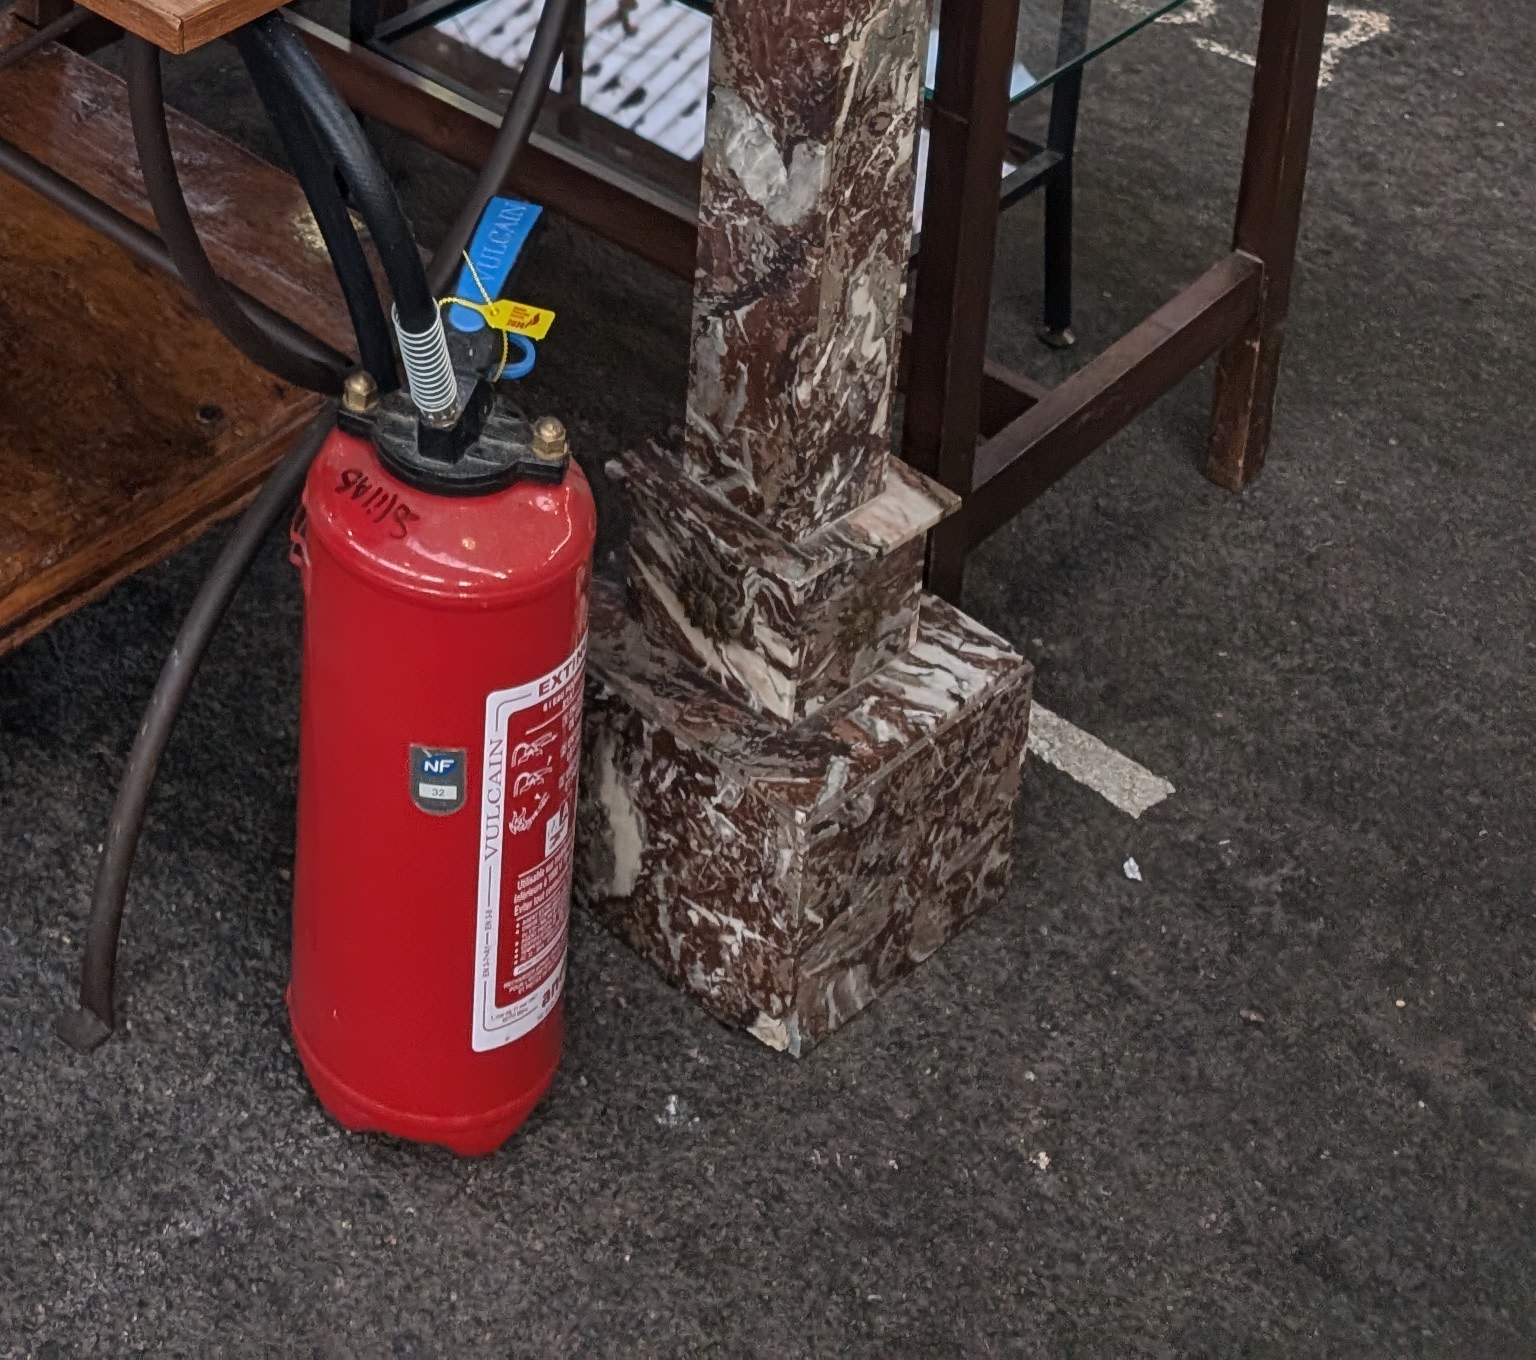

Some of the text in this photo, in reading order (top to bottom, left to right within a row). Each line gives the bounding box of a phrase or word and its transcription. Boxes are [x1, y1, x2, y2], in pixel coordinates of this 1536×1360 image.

[476, 201, 527, 281] VULCAIN
[539, 642, 586, 697] EXTIN
[424, 759, 455, 773] NF
[431, 788, 446, 798] 32
[484, 738, 504, 861] VULCAIN
